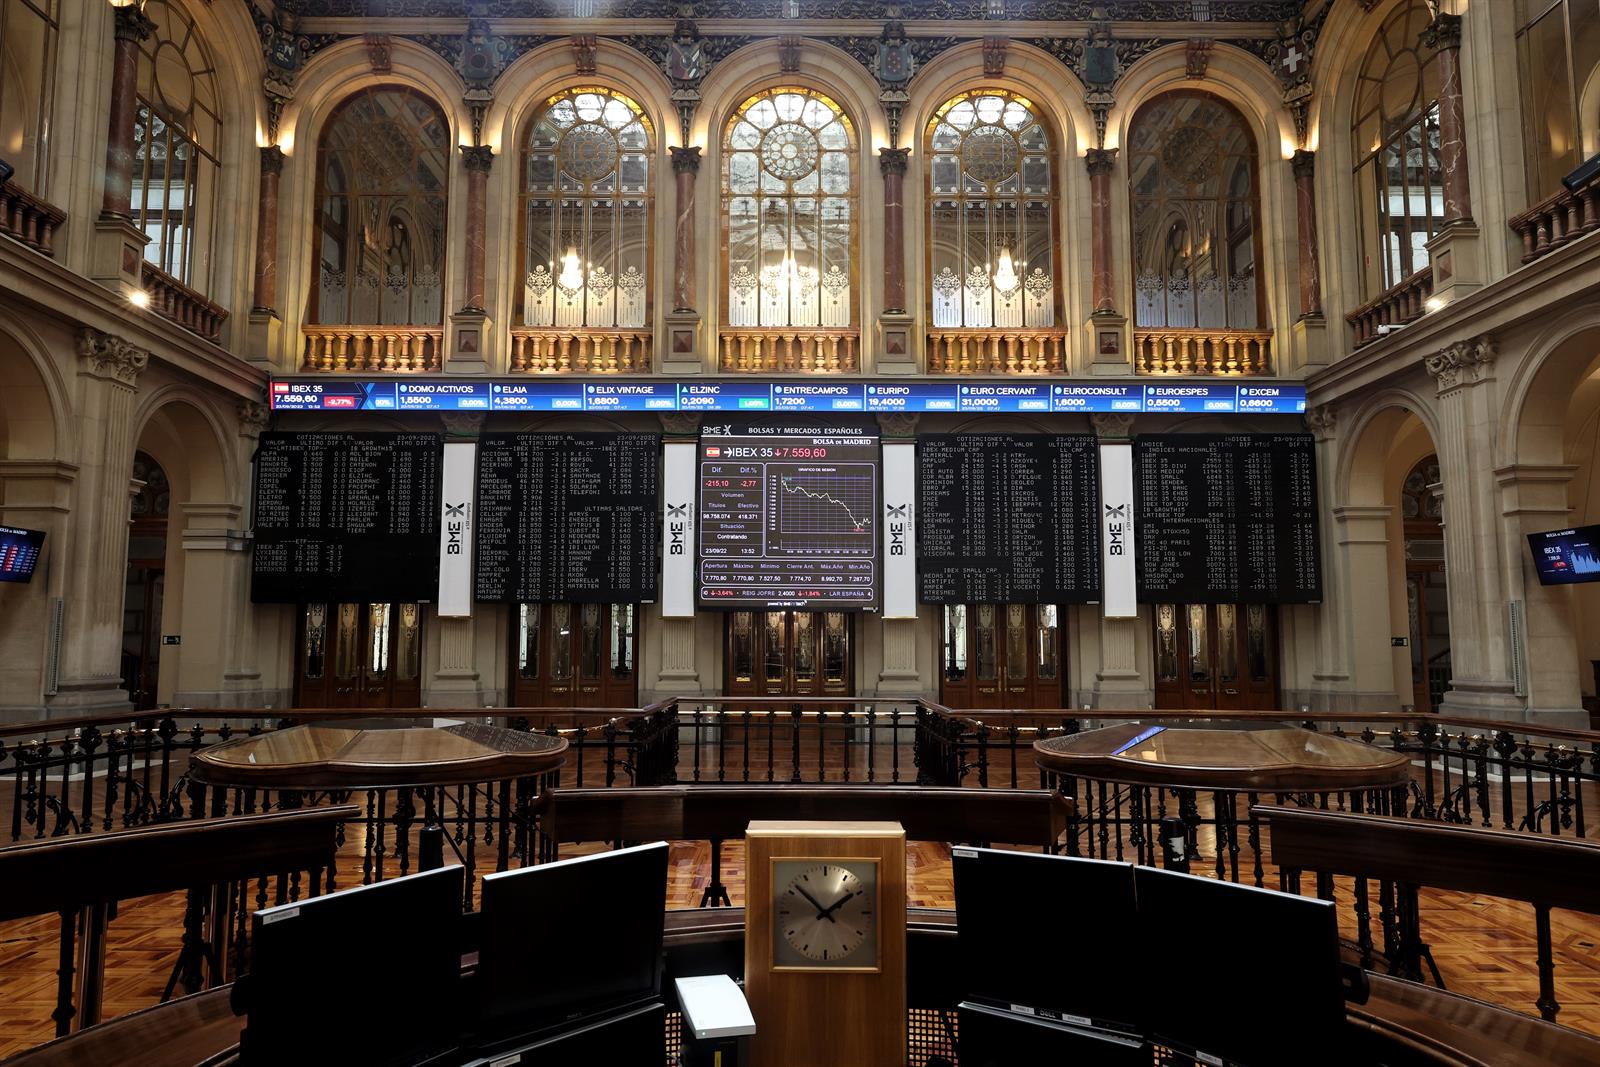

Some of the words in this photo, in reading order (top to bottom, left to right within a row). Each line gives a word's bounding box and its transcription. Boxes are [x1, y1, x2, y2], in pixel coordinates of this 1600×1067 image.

[275, 395, 318, 403] 7.559,60
[494, 397, 527, 405] 4,3800
[732, 448, 757, 457] IBEX
[760, 448, 773, 457] 35
[783, 448, 826, 458] 7.559,60
[447, 521, 461, 554] BME
[670, 522, 683, 555] BME
[890, 522, 903, 556] BME
[1109, 523, 1122, 556] BME
